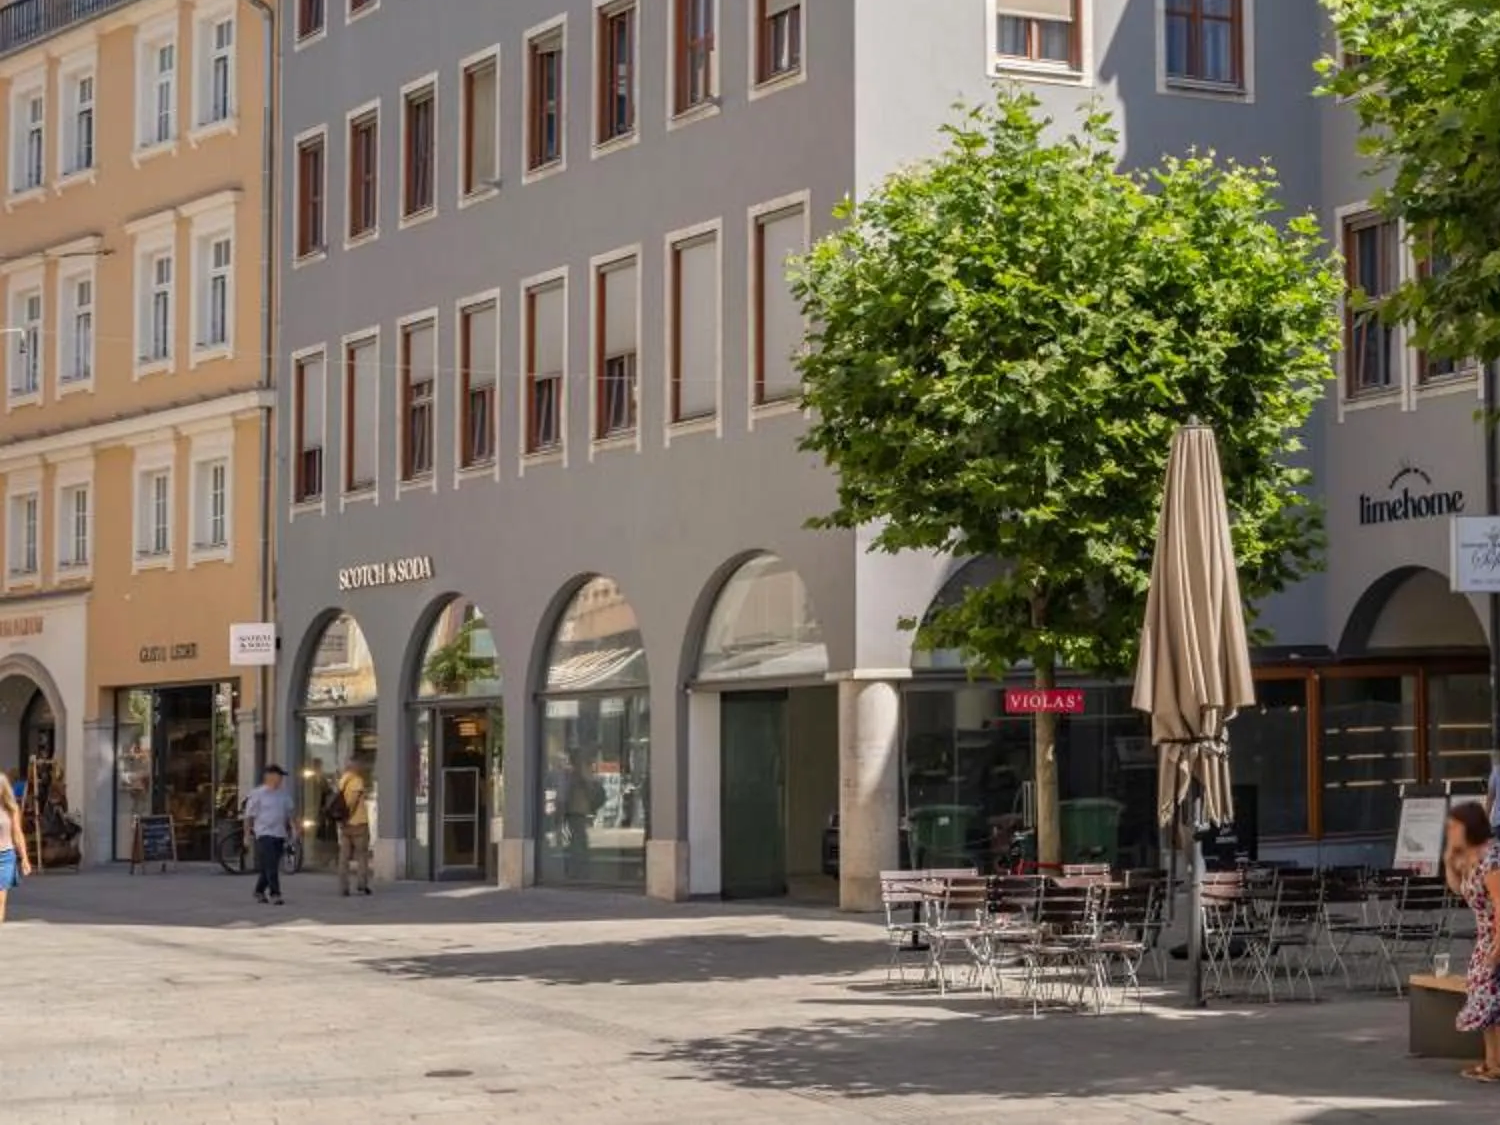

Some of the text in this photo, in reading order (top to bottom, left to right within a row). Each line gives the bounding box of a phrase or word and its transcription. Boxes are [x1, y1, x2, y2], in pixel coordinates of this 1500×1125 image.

[1359, 487, 1465, 525] limehome
[339, 562, 385, 590] SCOTCH
[397, 556, 433, 582] SODA
